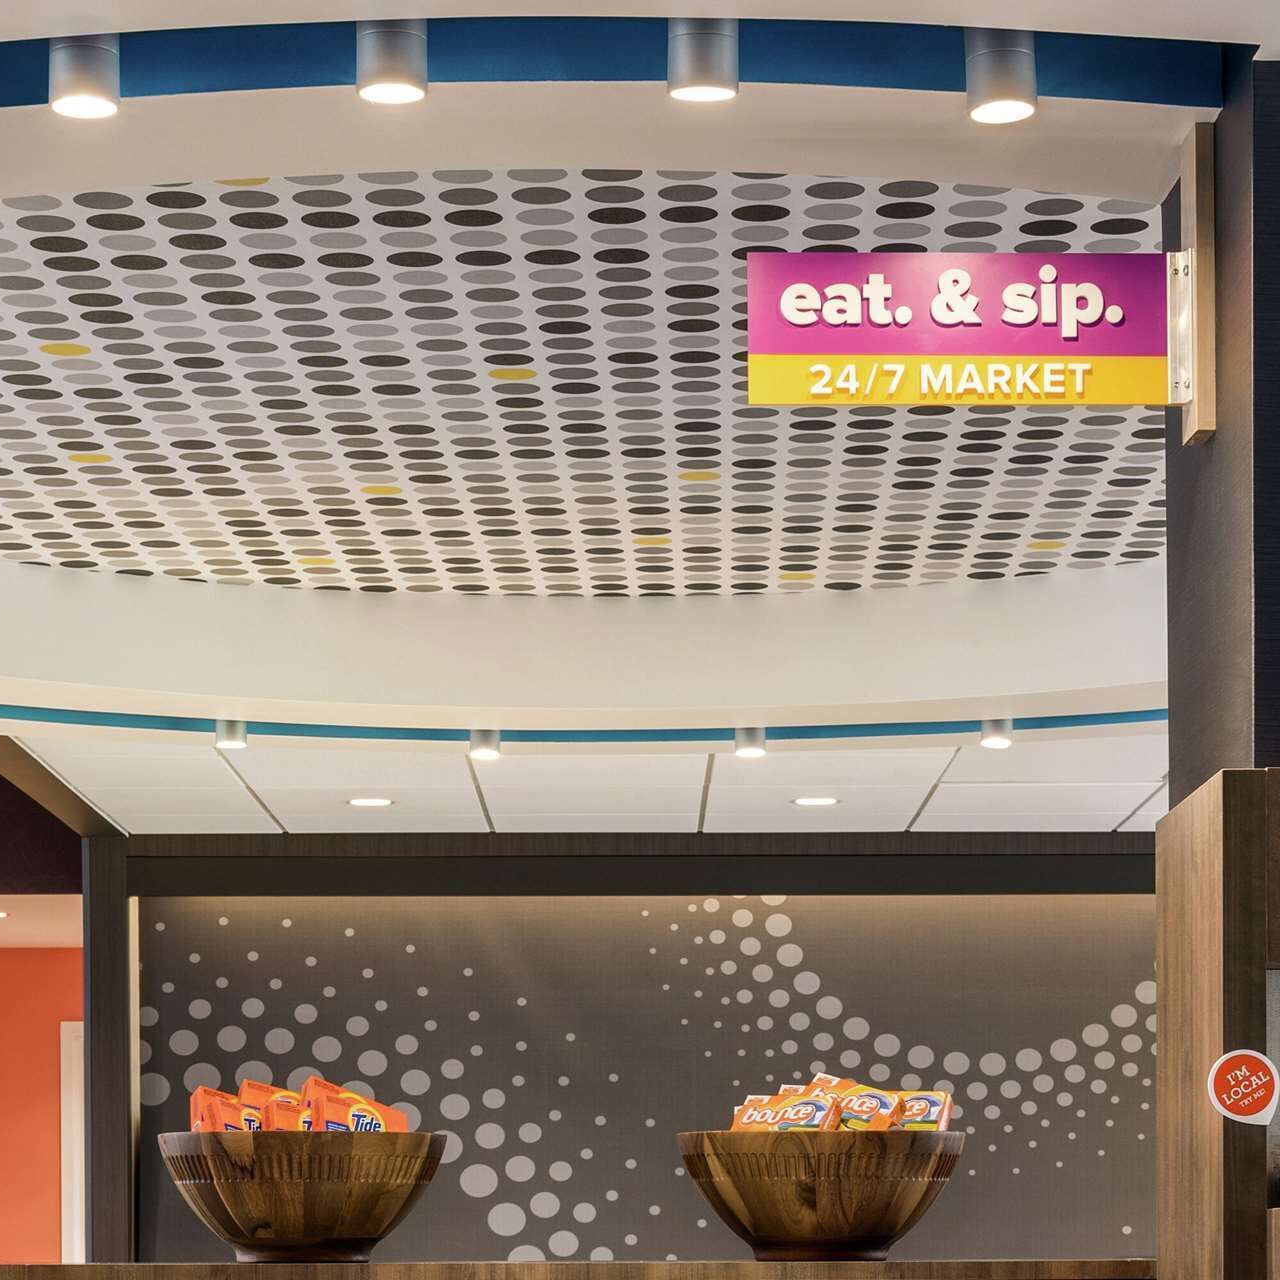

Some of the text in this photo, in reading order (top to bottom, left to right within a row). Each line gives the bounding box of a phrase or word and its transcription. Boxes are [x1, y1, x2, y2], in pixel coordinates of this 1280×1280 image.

[779, 264, 1125, 339] eat. & sip.
[809, 363, 1092, 395] 24/7 MARKET
[1221, 1071, 1270, 1105] LOCAL
[1226, 1065, 1250, 1086] I'M
[351, 1112, 382, 1132] Tide
[741, 1103, 813, 1124] bounce
